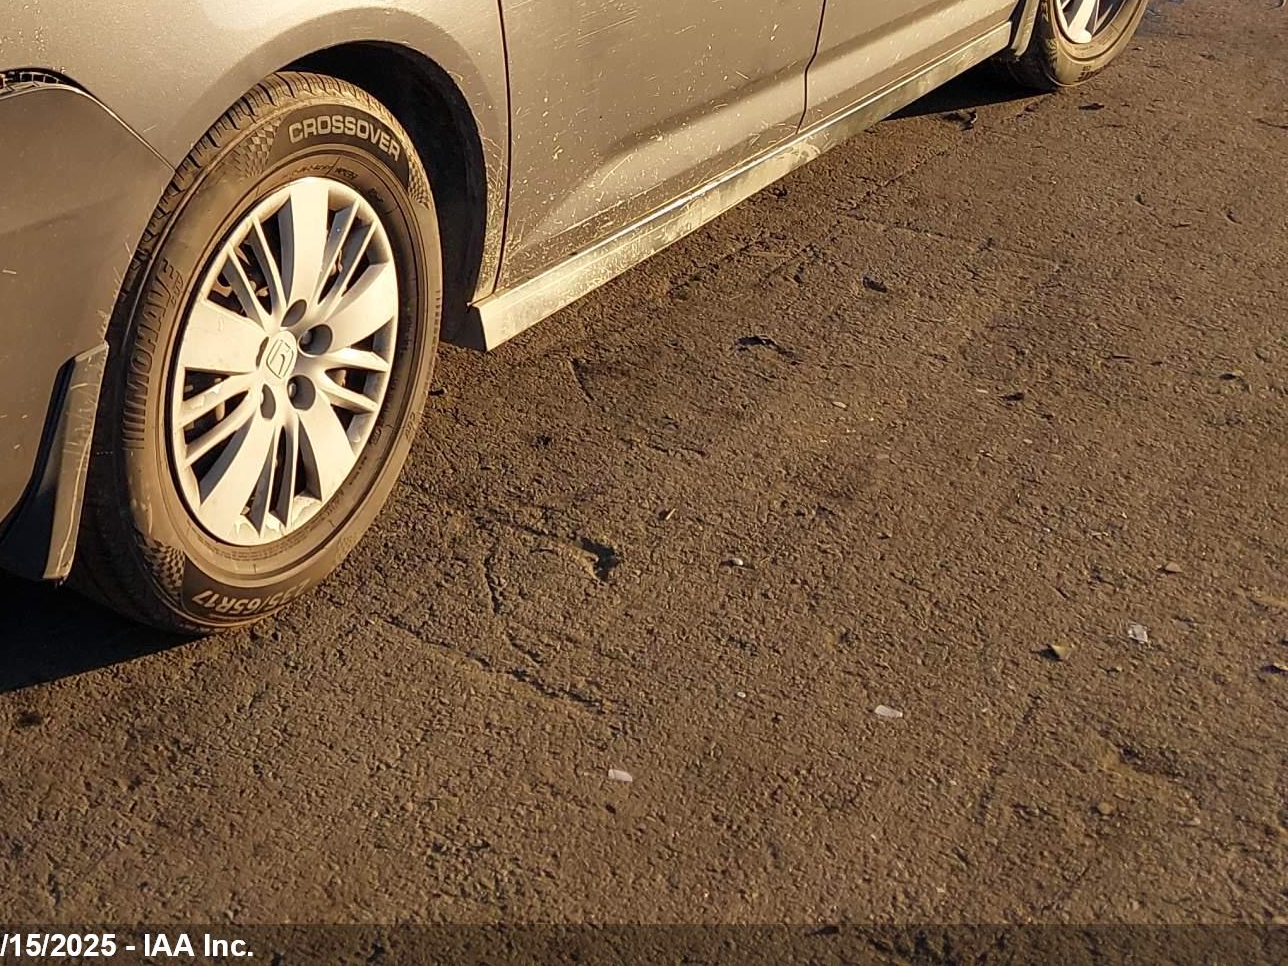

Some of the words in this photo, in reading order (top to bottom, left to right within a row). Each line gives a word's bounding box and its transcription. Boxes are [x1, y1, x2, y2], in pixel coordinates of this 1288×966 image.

[288, 114, 401, 162] CROSSOVER
[124, 258, 179, 407] MOHAVE
[191, 577, 312, 615] 235/65R17
